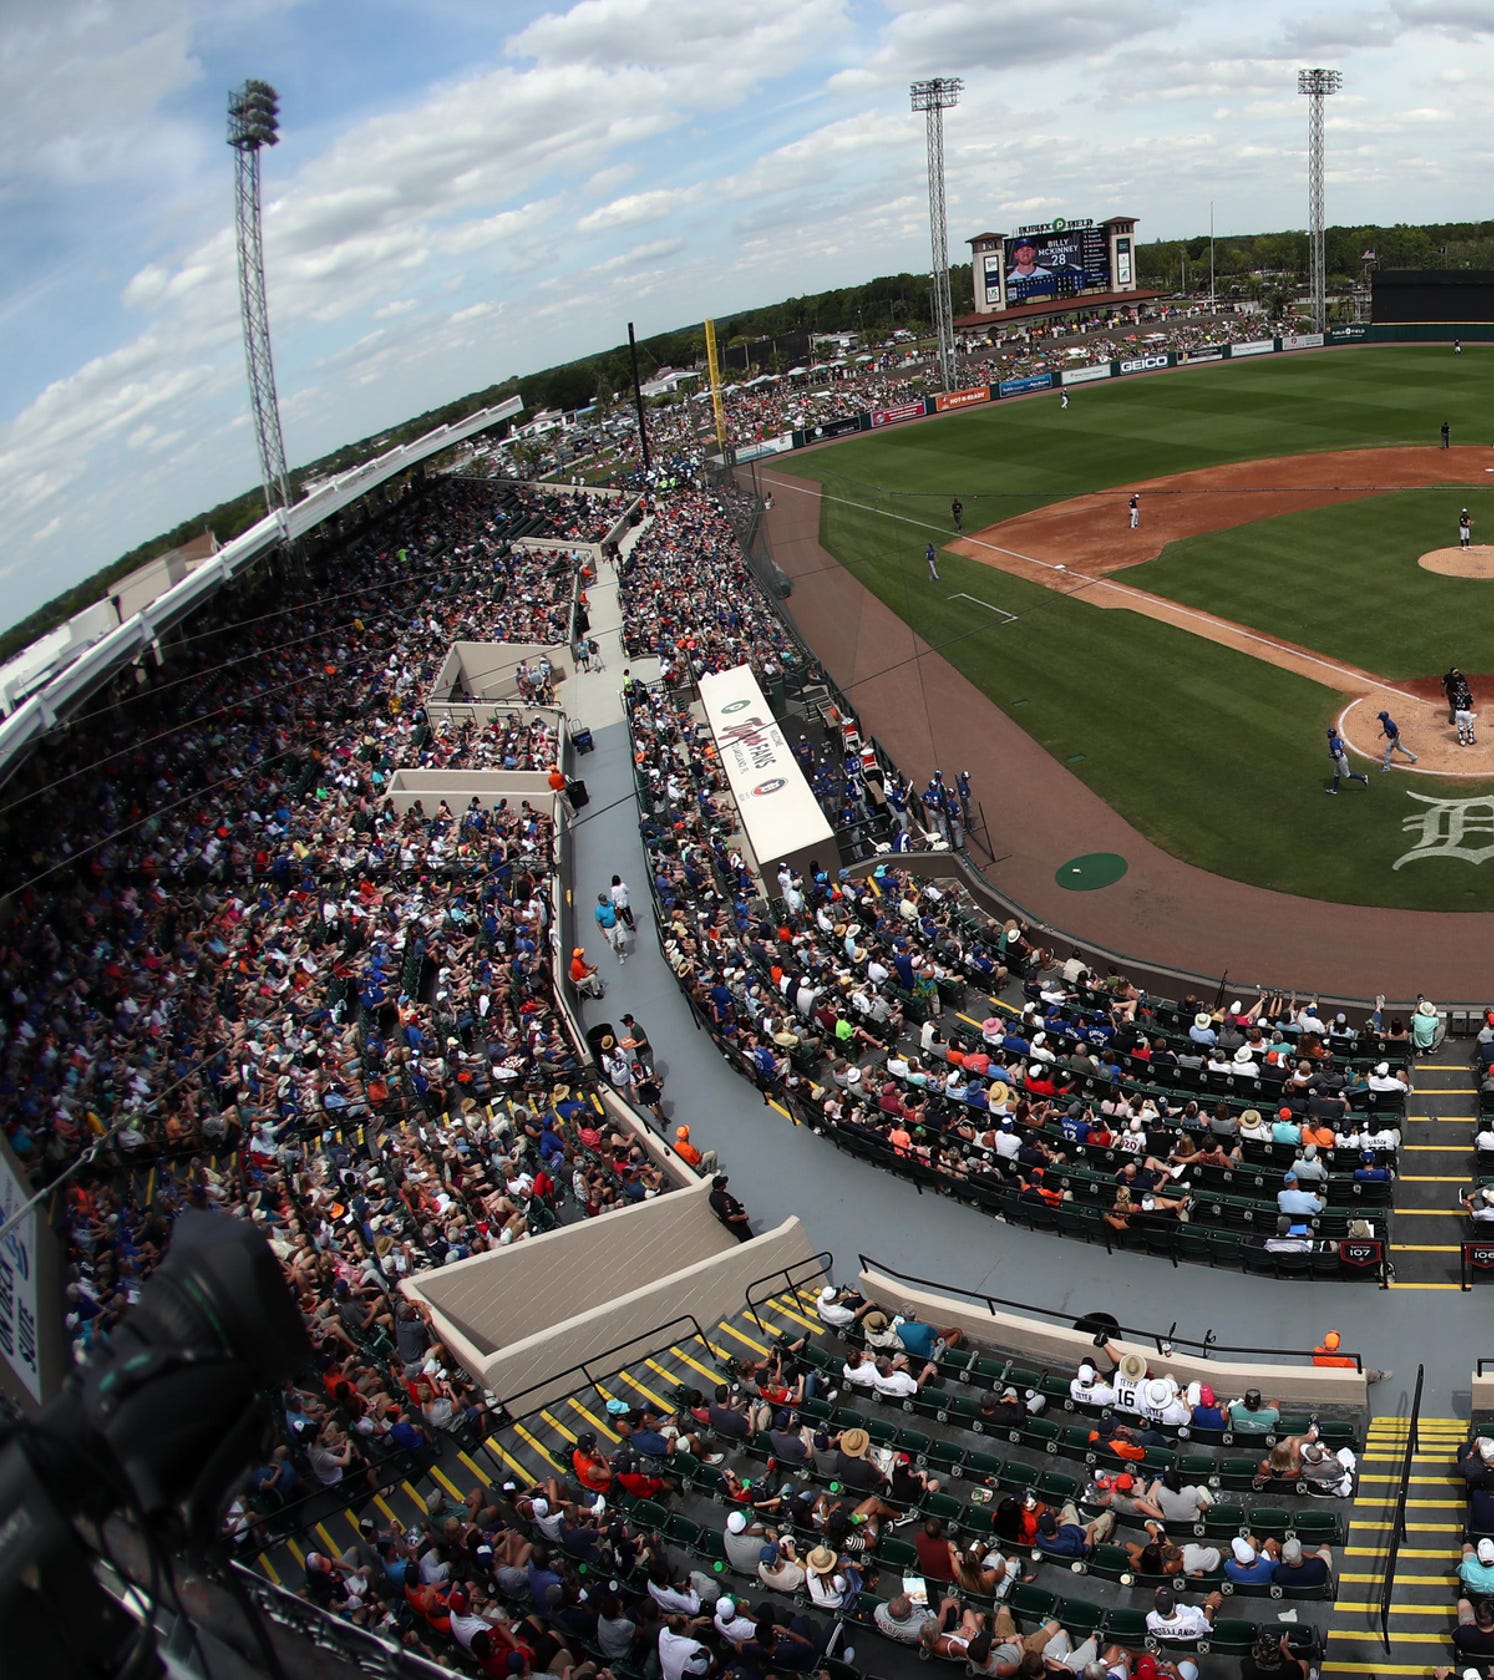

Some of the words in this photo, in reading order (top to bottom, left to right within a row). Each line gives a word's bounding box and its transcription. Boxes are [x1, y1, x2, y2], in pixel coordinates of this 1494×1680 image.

[1067, 219, 1094, 228] FIELD
[1047, 239, 1069, 248] BILLY
[1038, 245, 1079, 256] MCKINNEY
[1051, 253, 1066, 266] 28
[1121, 355, 1168, 373] GEICO
[749, 744, 776, 769] FANS
[1063, 1130, 1077, 1142] 12
[1124, 1140, 1137, 1150] 20
[1350, 1249, 1371, 1257] 107
[17, 1297, 37, 1375] SUITE
[1117, 1388, 1135, 1407] 16
